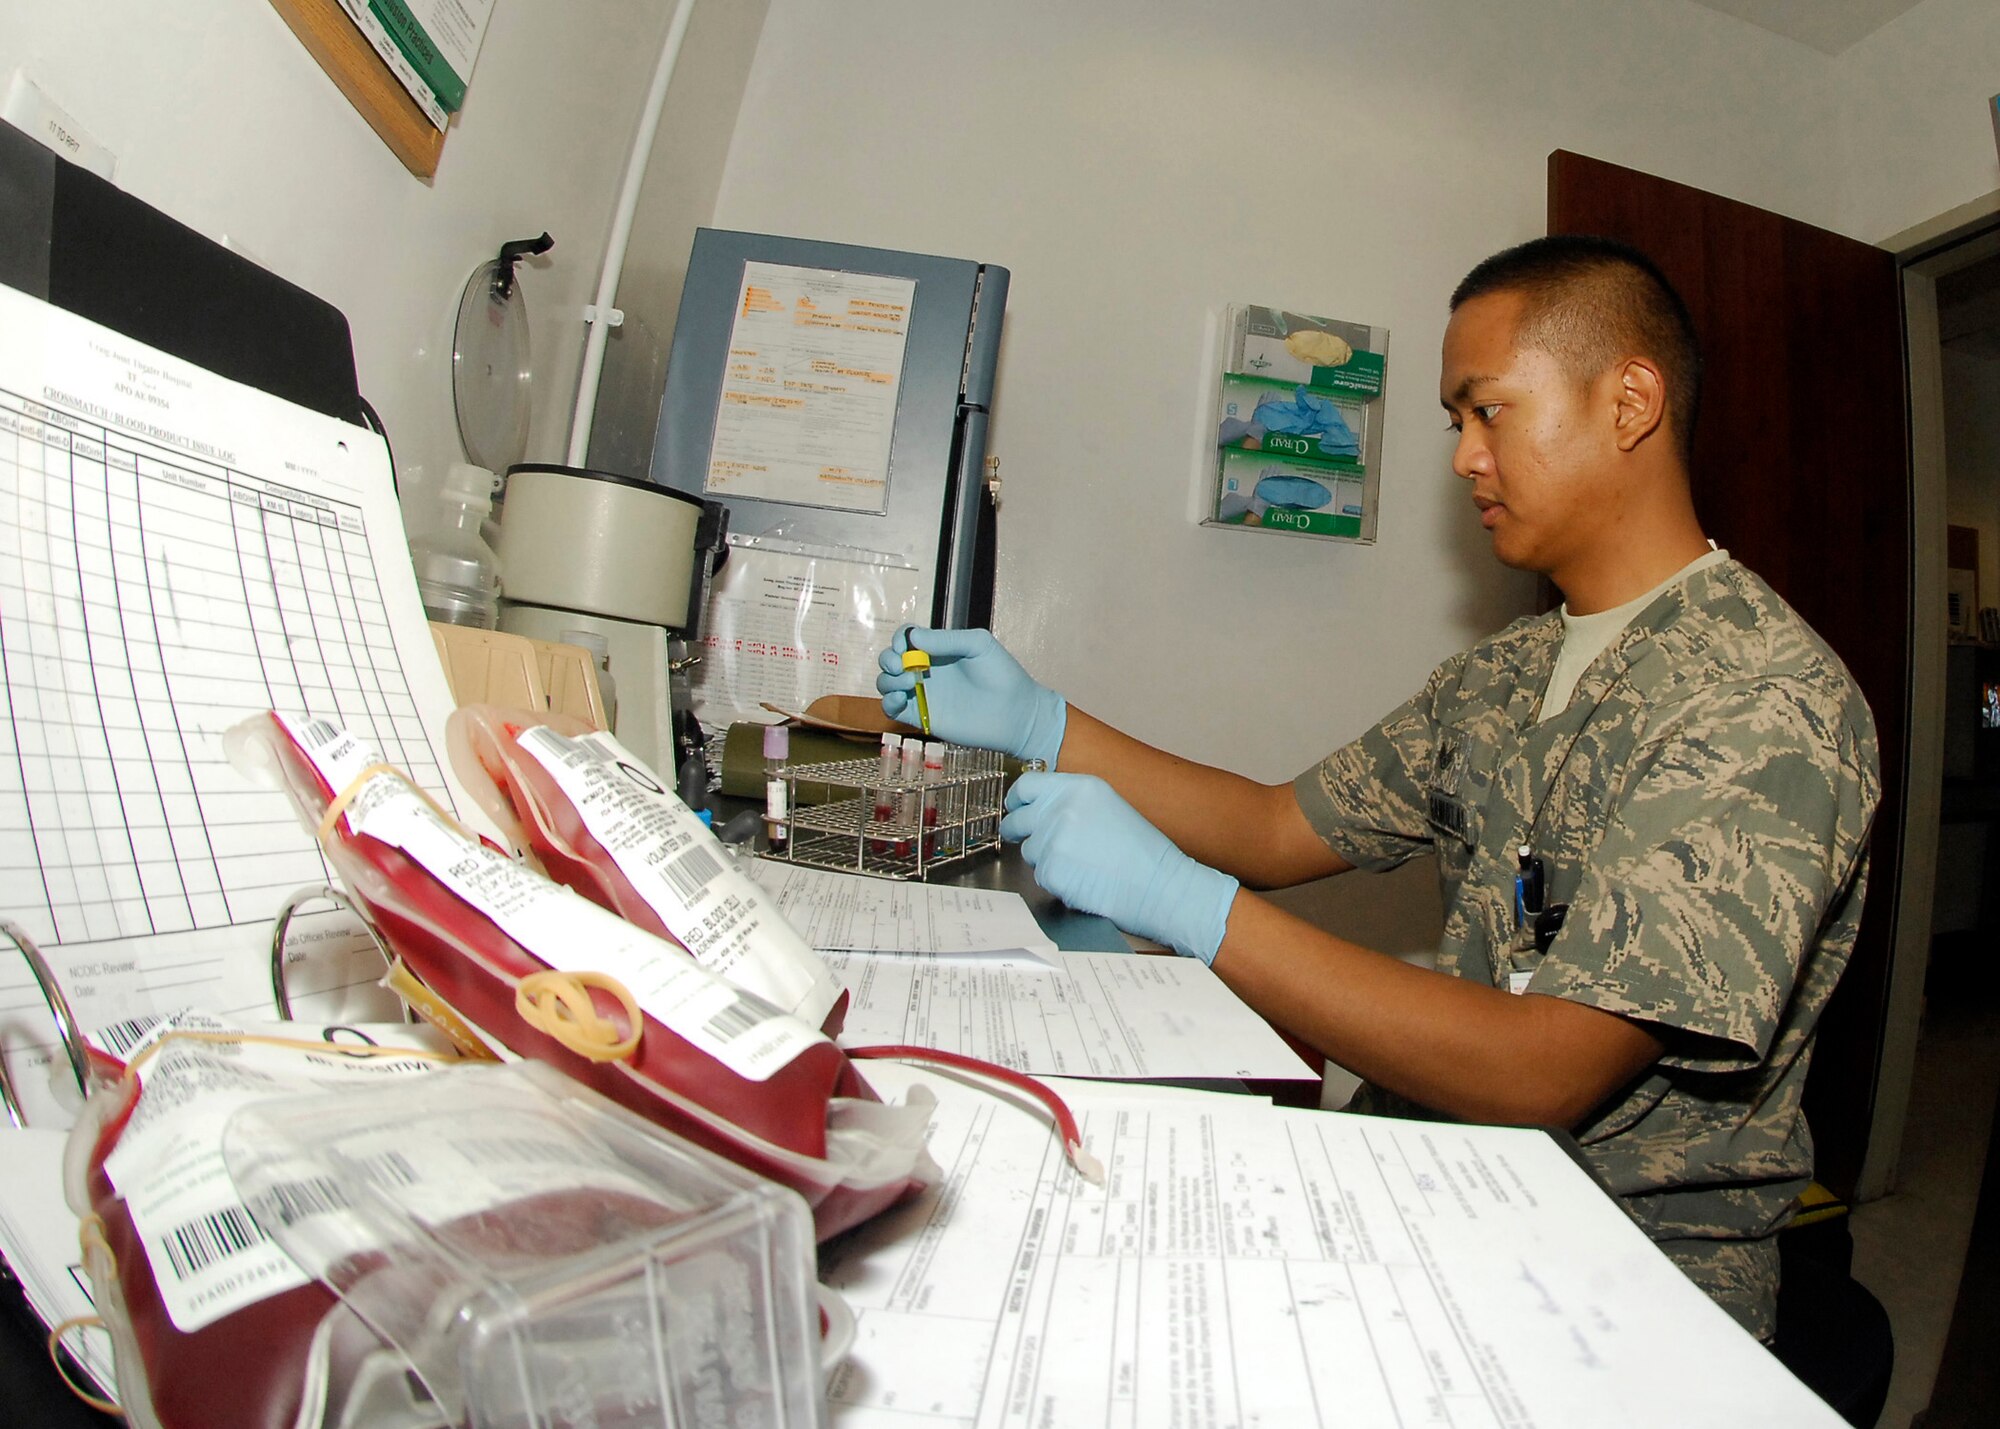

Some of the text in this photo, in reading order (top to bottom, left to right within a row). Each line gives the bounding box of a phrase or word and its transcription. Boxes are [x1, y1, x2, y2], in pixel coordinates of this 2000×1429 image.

[112, 350, 131, 365] Joint
[133, 355, 161, 377] Theater
[162, 367, 193, 390] Hospital
[114, 382, 133, 396] APO
[147, 392, 170, 410] 09354
[1334, 380, 1378, 393] SensiCare
[22, 400, 49, 422] Patient
[19, 422, 43, 439] anti-B
[43, 384, 108, 419] CROSSMATCH
[114, 410, 146, 430] BLOOD
[148, 420, 190, 446] PRODUCT
[191, 434, 215, 454] ISSUE
[217, 442, 237, 462] LOG
[46, 432, 70, 448] anti-D
[1270, 435, 1309, 455] CURAD
[162, 468, 207, 490] Unit Number
[264, 482, 330, 510] Compatibility Testing
[1271, 511, 1311, 530] CURAD
[448, 858, 479, 879] RED
[683, 926, 704, 946] RED
[703, 904, 728, 930] BLOOD
[284, 935, 299, 948] Lab
[324, 927, 352, 940] Review
[288, 951, 307, 964] Date
[69, 962, 102, 979] NCOIC
[74, 983, 96, 999] Date
